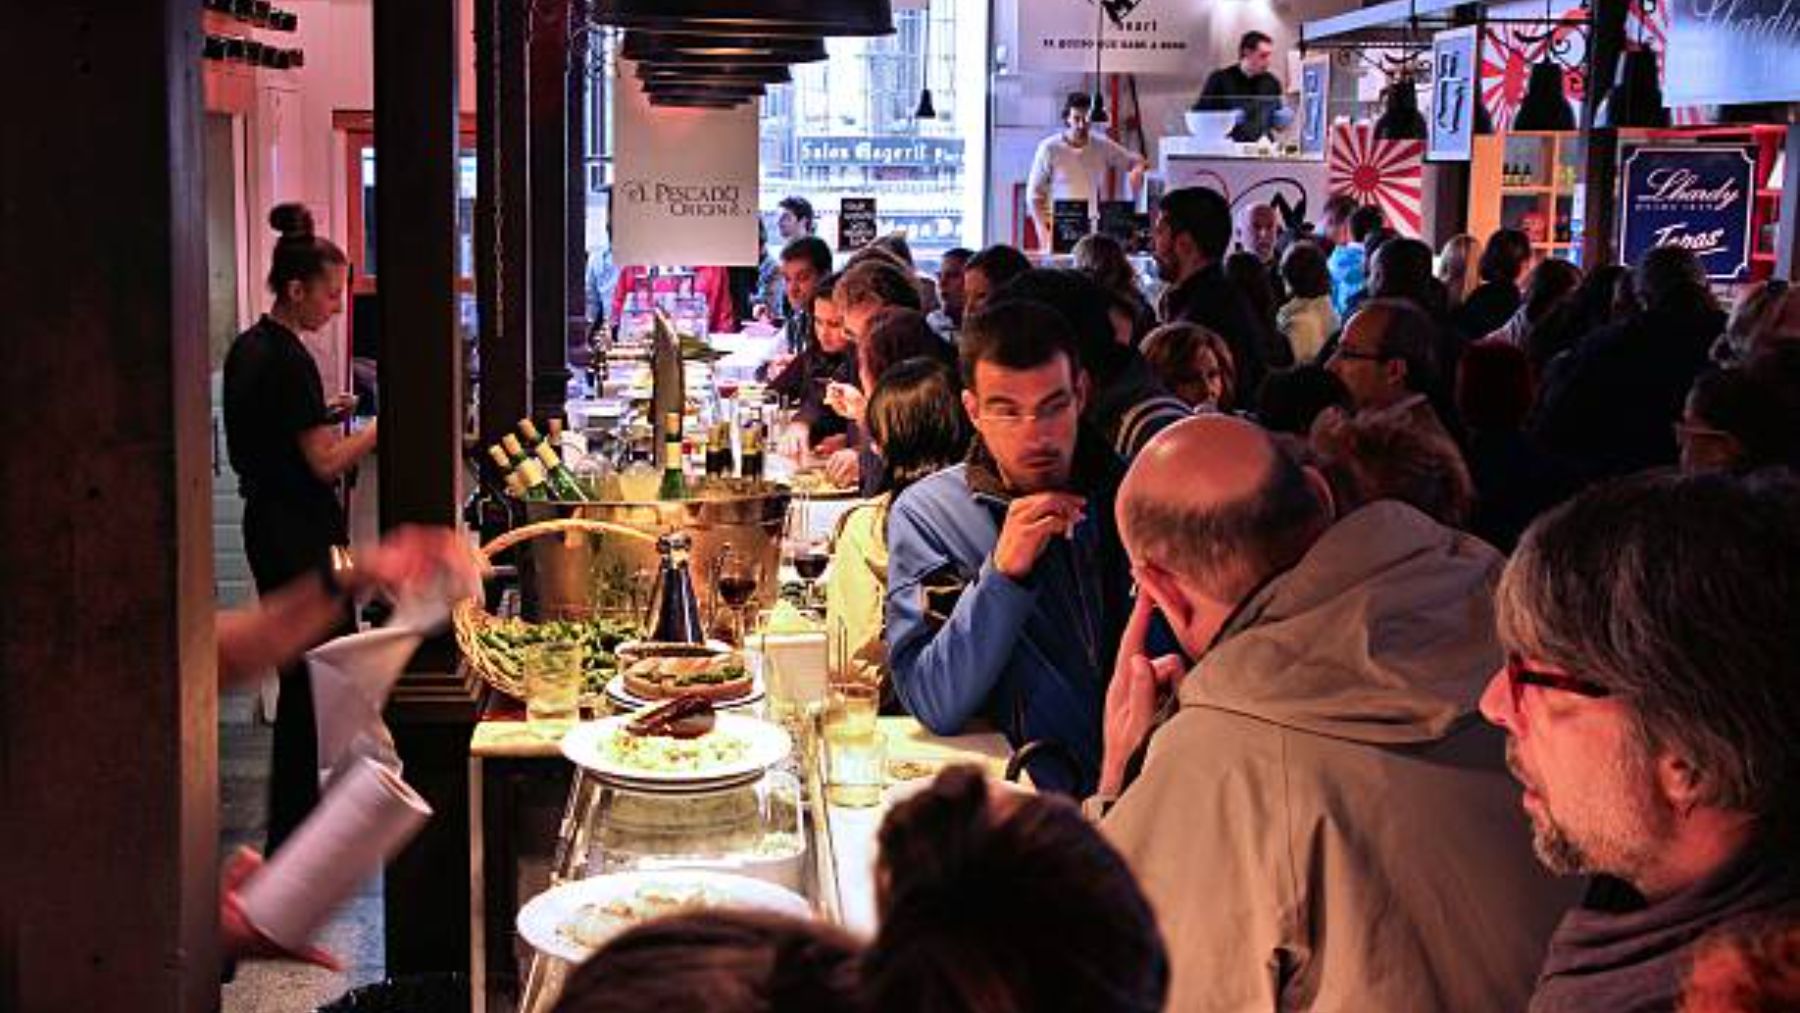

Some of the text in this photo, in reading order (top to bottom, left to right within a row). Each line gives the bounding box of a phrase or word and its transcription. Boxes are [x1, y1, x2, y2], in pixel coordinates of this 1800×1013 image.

[655, 182, 739, 203] PESCADO
[1646, 168, 1739, 211] Lhardy
[670, 202, 750, 216] ORIGINA
